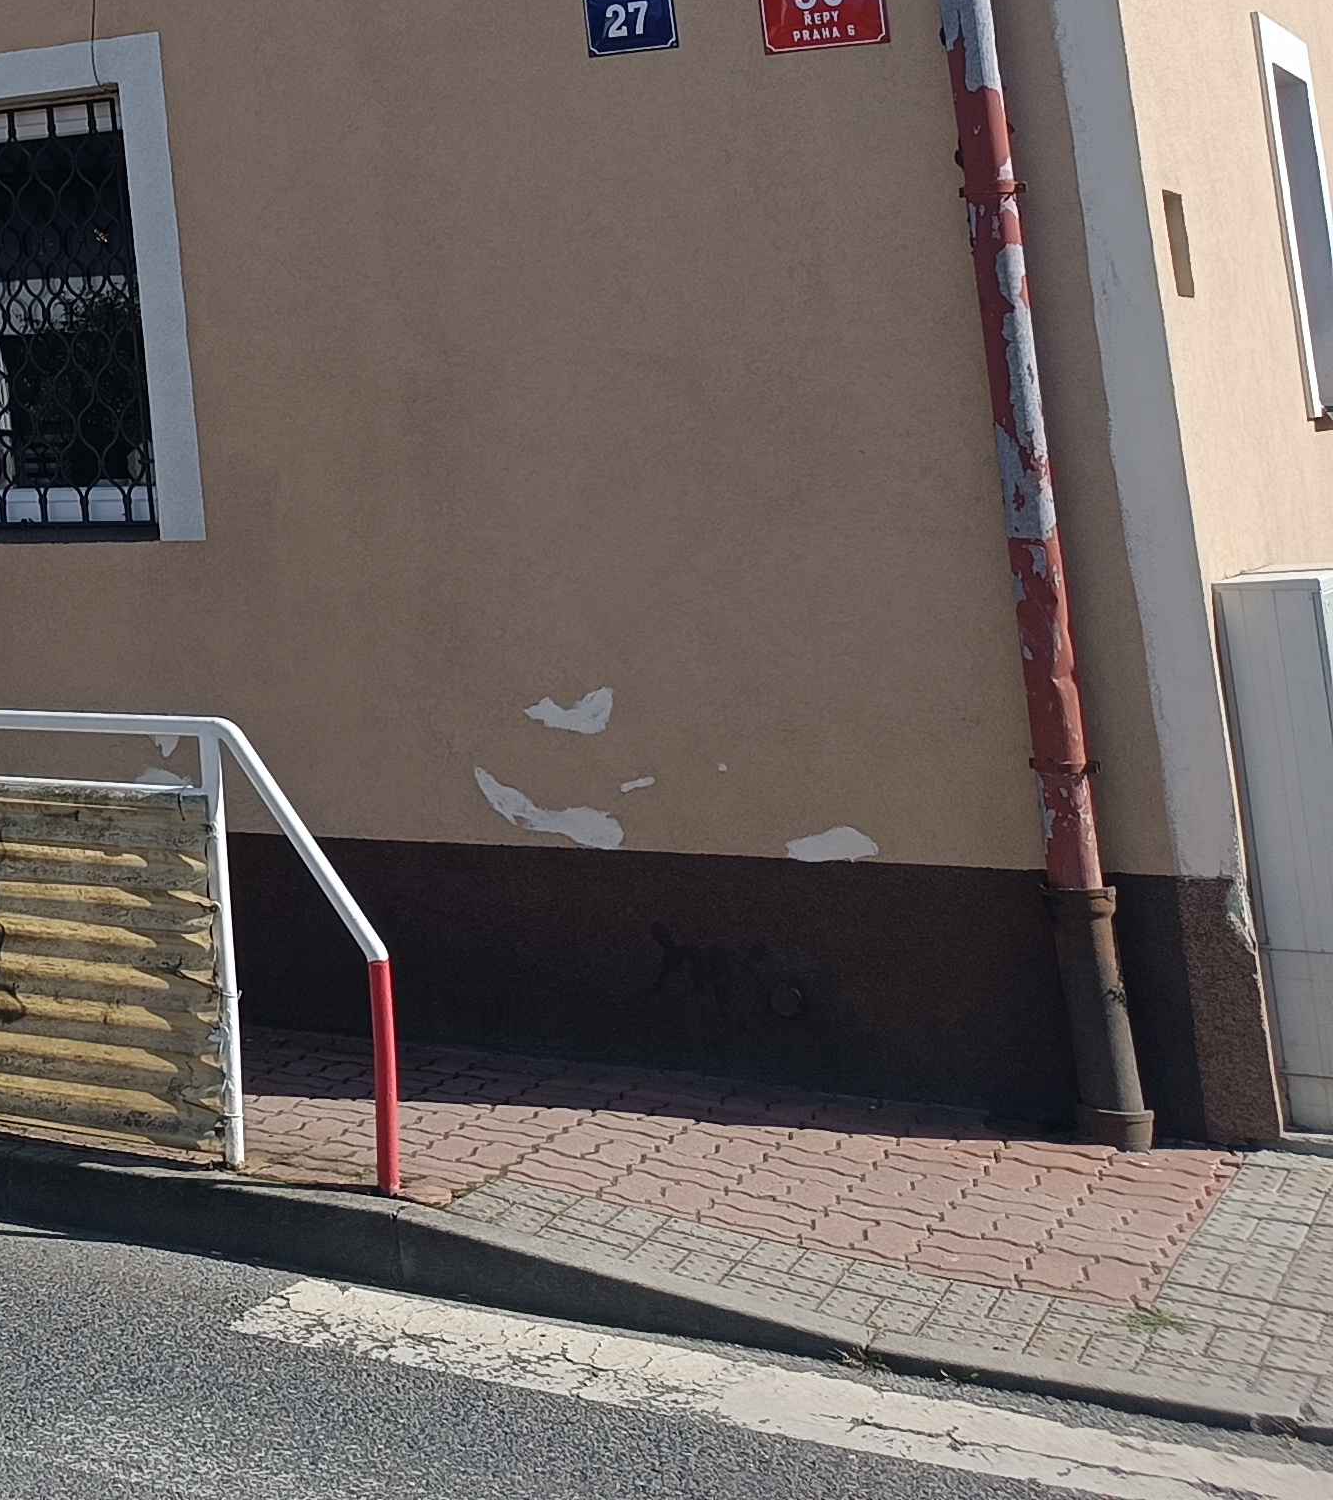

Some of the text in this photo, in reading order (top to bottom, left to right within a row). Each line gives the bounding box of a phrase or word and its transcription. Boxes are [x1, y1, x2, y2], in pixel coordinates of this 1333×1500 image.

[605, 0, 649, 38] 27
[803, 10, 839, 26] ŘEPY
[792, 24, 856, 42] PRAHA 6
